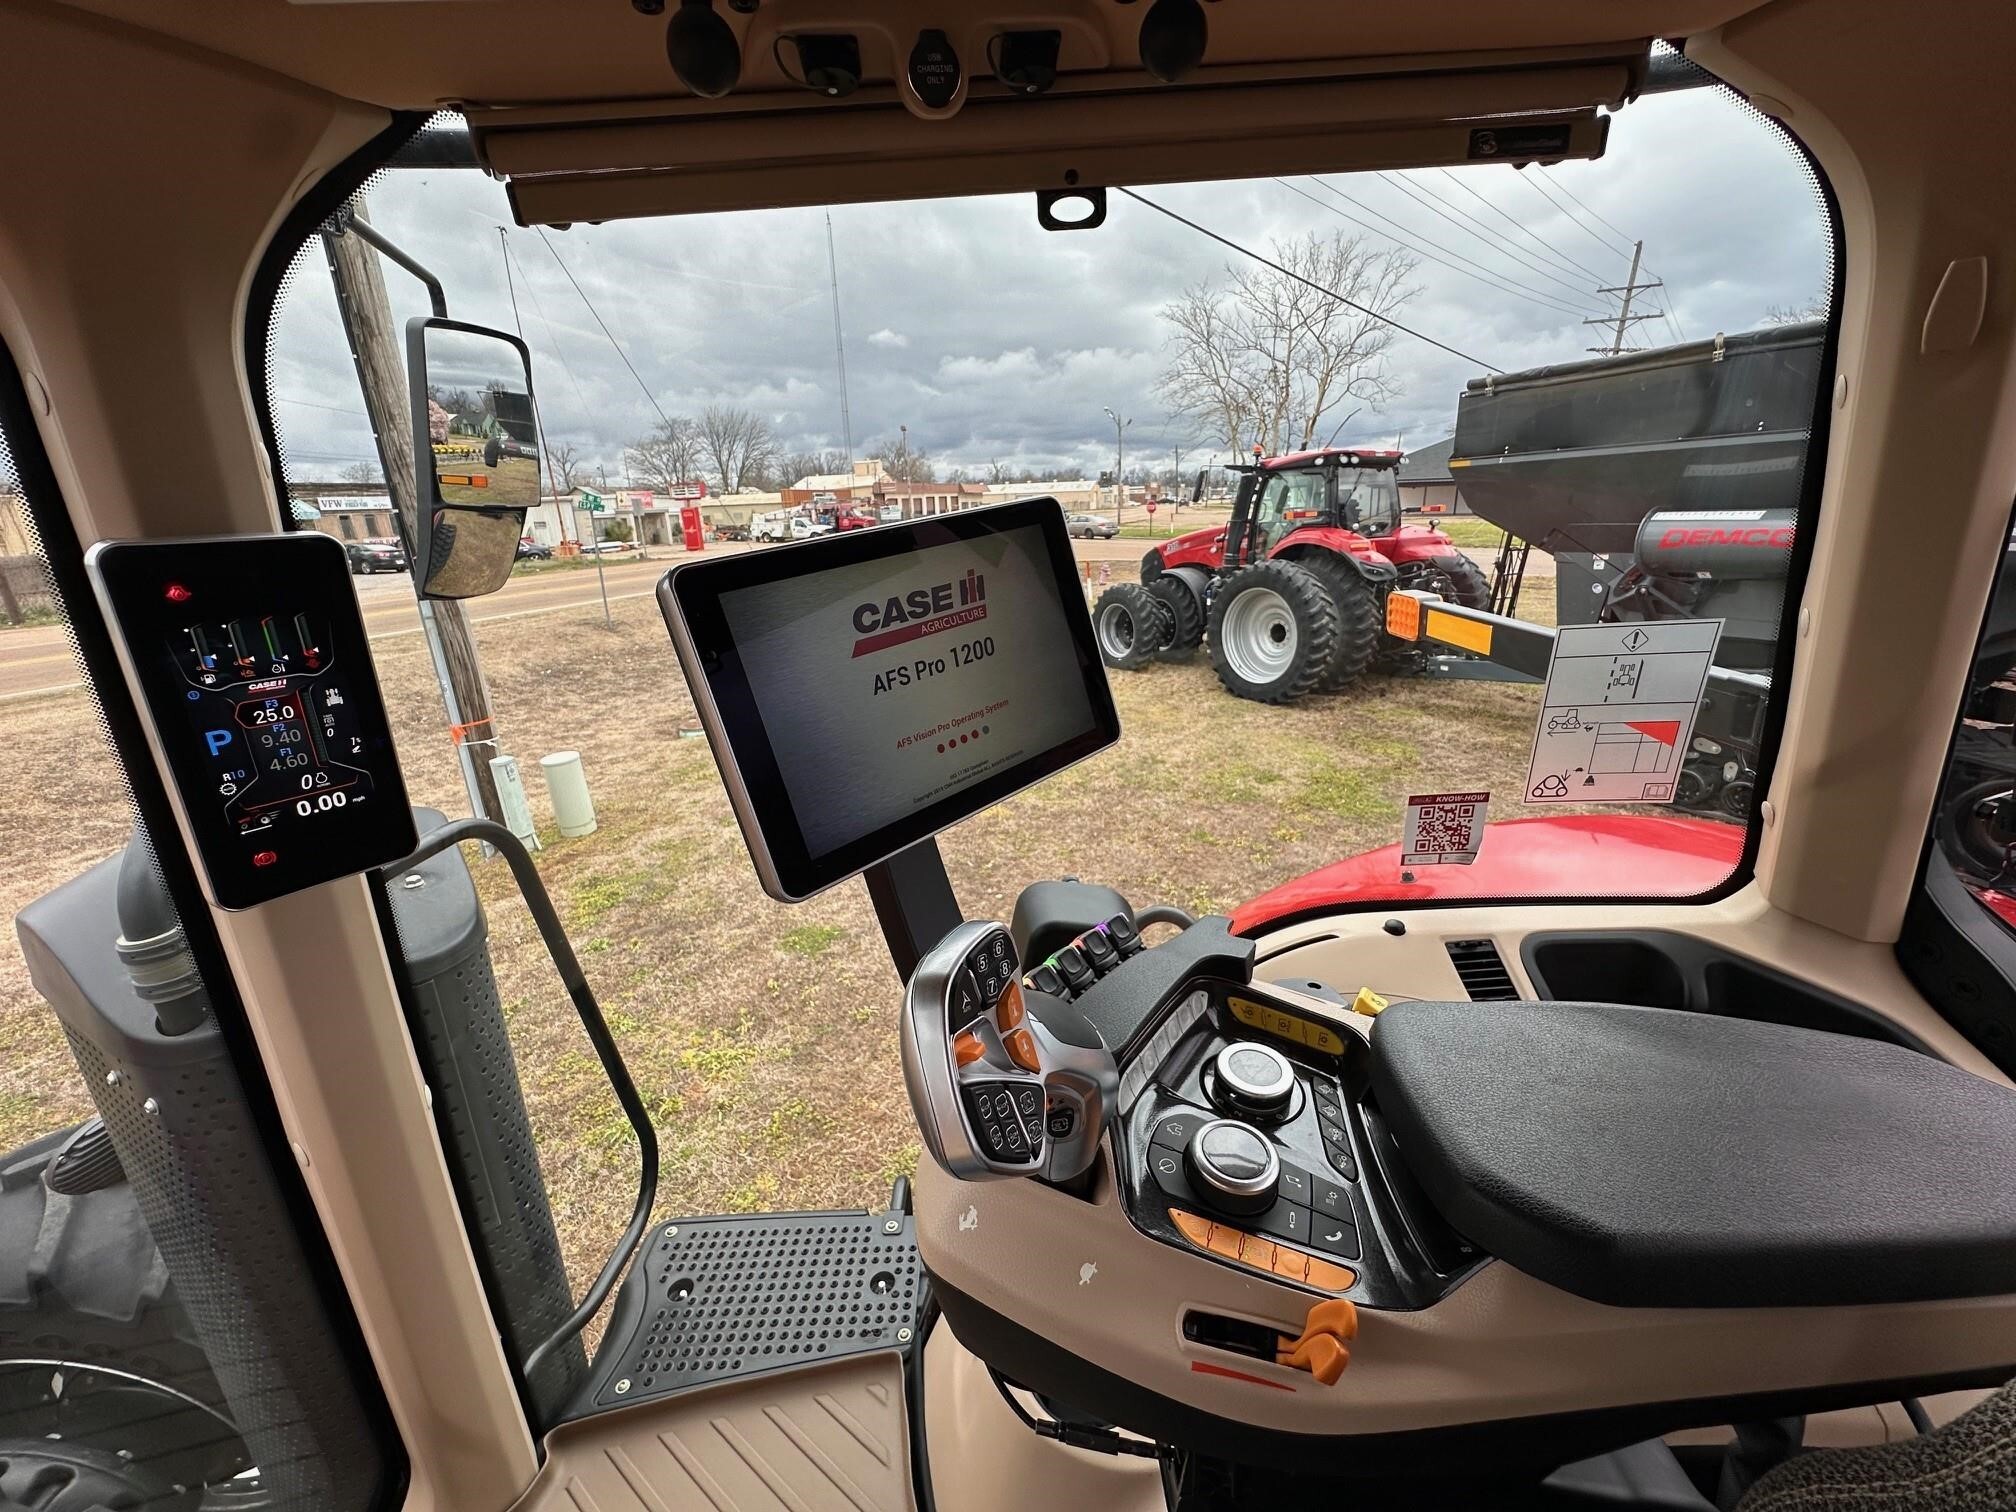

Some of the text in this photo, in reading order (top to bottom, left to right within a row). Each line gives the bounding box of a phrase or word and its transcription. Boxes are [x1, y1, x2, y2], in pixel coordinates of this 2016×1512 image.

[916, 64, 955, 73] CHARGING
[926, 75, 945, 85] ONLY
[321, 499, 343, 509] VFW
[852, 583, 954, 634] CASE
[920, 607, 986, 636] AGRICULTURE
[873, 636, 996, 696] AFS Pro 1200
[248, 681, 277, 691] CASE
[264, 699, 279, 709] F3
[252, 705, 295, 725] 25.0
[272, 723, 287, 733] F2
[896, 699, 1010, 750] AFS Vision Pro Operating System
[261, 729, 302, 748] 9.40
[326, 728, 335, 738] 0
[205, 729, 232, 756] P
[279, 747, 293, 757] F1
[269, 752, 309, 771] 4.60
[301, 774, 313, 790] 0
[296, 791, 347, 817] 0.00
[1435, 793, 1486, 803] KNOW-HOW
[995, 942, 1002, 954] 6
[980, 956, 986, 969] 5
[1002, 962, 1008, 975] 8
[988, 980, 995, 993] 7
